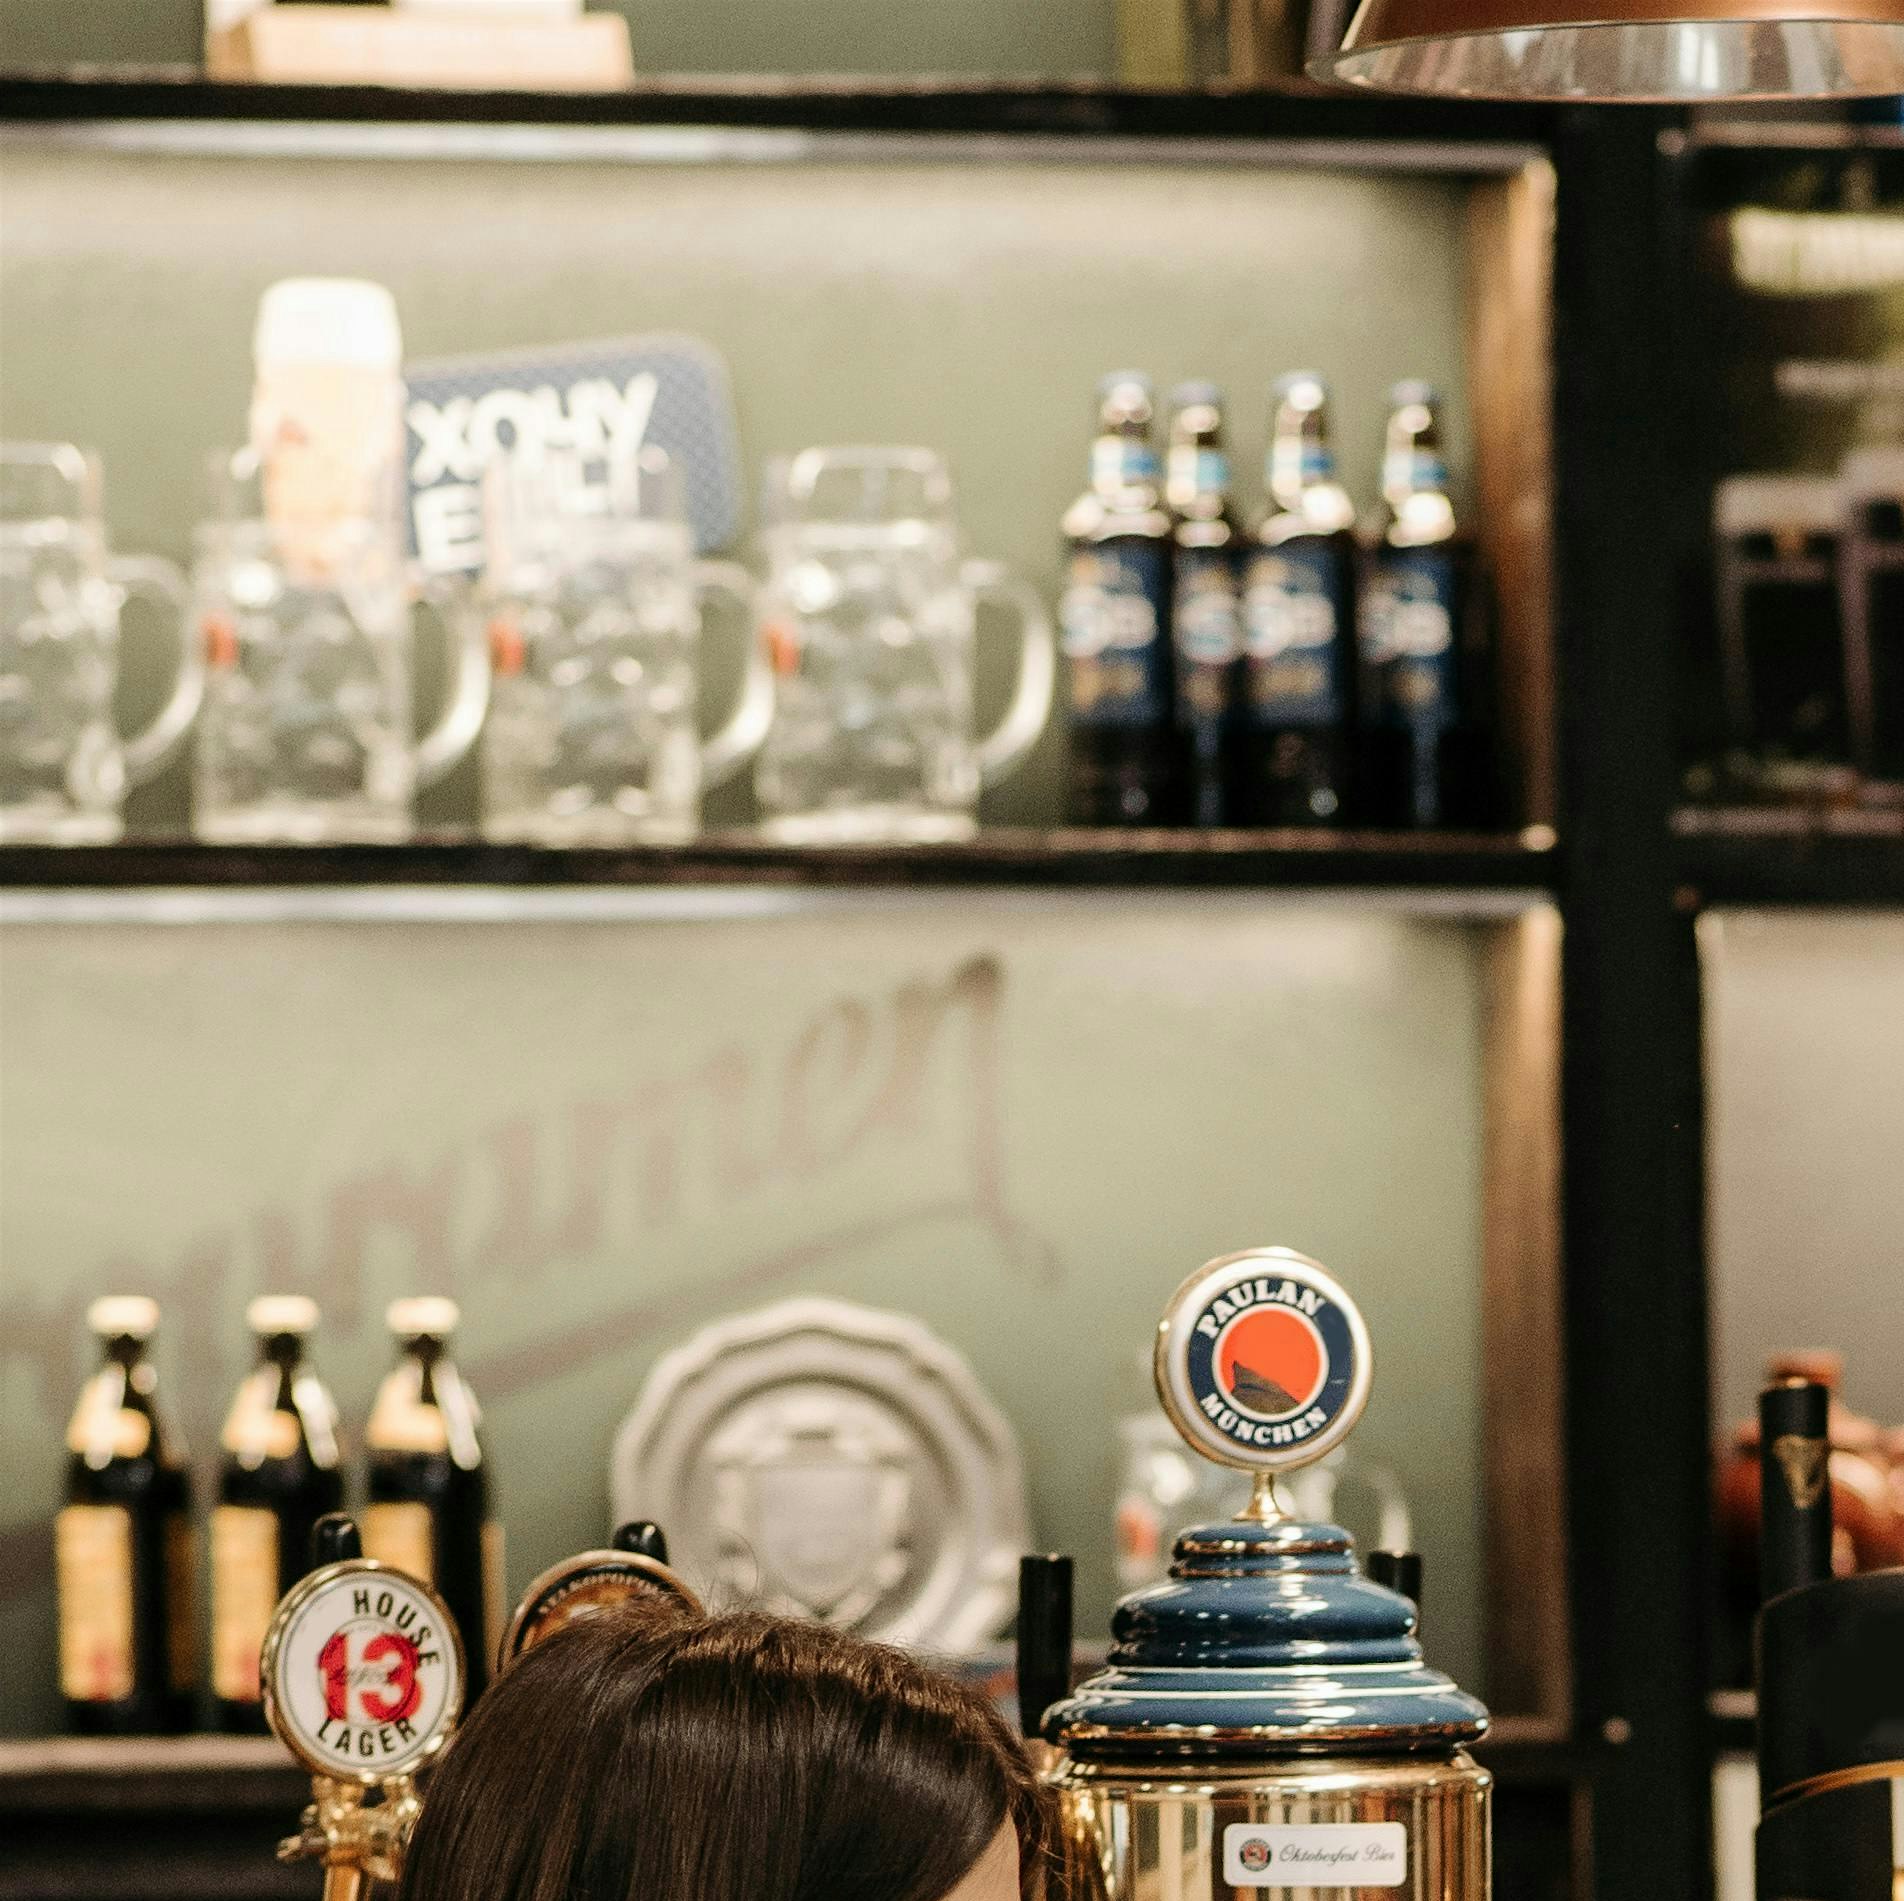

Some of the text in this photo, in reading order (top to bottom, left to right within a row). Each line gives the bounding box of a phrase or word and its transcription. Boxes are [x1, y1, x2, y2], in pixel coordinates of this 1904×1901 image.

[353, 1588, 440, 1668] HOUSE
[318, 1632, 424, 1722] 13
[317, 1717, 417, 1757] LAGER
[1279, 1842, 1358, 1866] Oktoberfest
[1361, 1842, 1395, 1862] Bier
